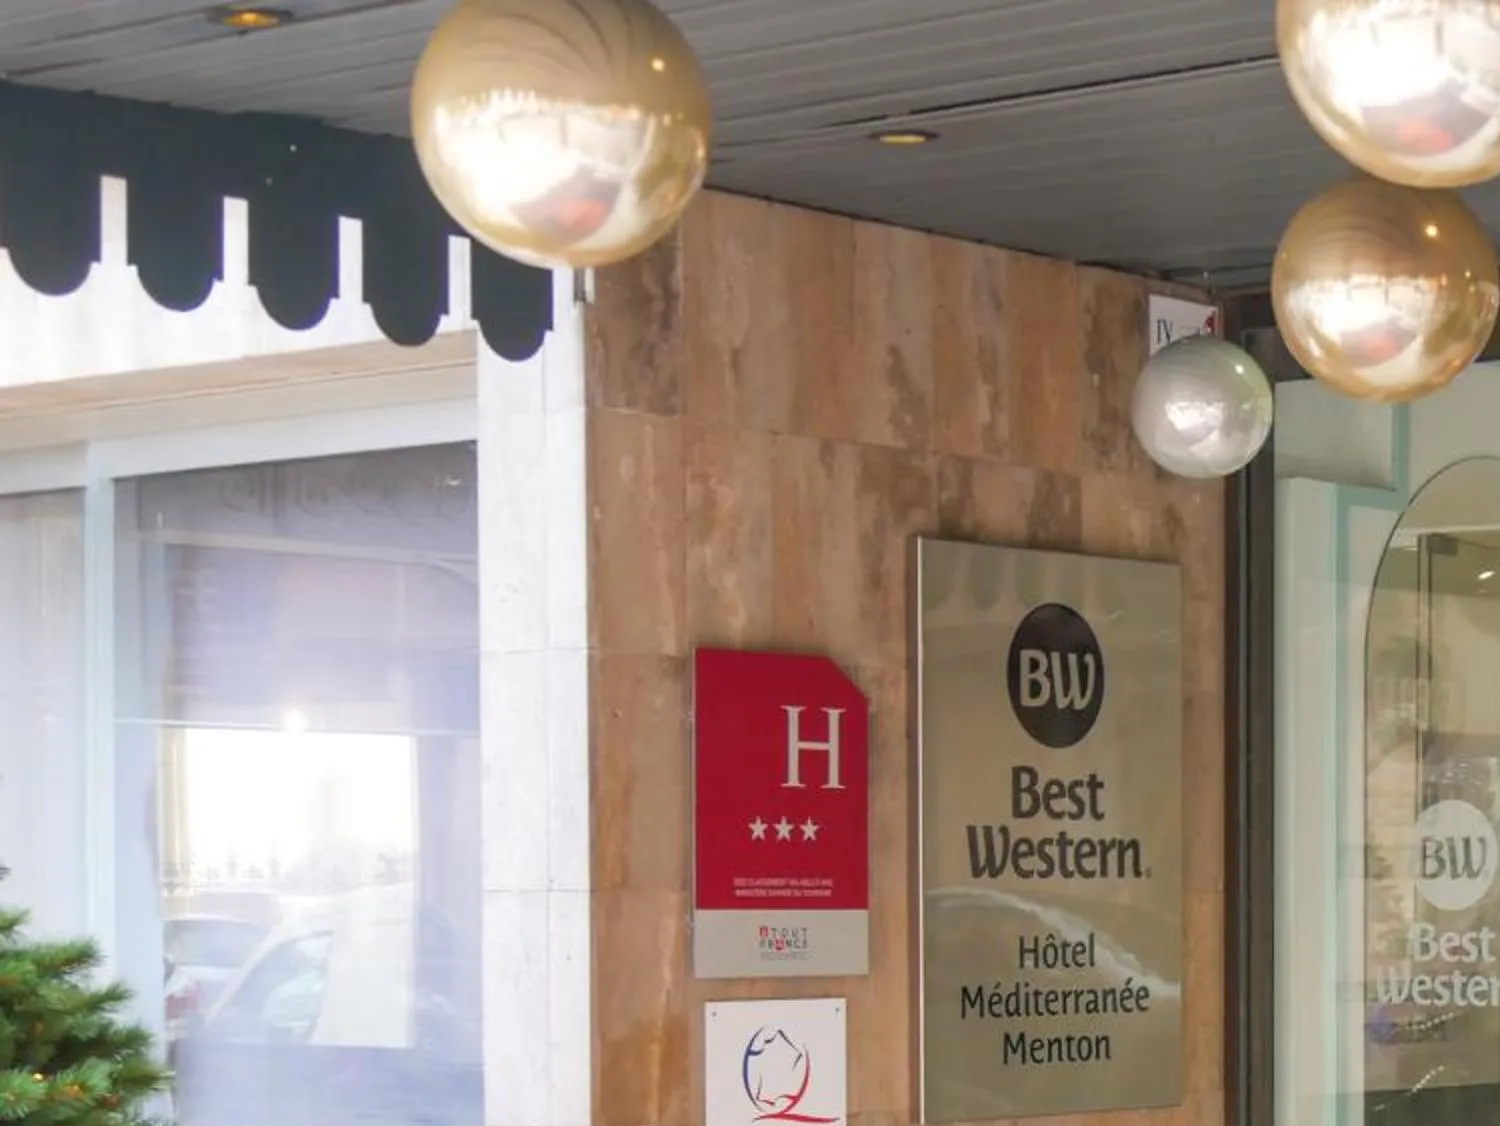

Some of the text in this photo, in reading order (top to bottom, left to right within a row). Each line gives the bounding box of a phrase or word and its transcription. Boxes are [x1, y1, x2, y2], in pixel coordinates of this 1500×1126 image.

[1019, 648, 1097, 710] BW
[780, 705, 848, 789] H
[1011, 765, 1106, 821] Best
[966, 824, 1145, 880] Western
[1420, 835, 1488, 880] BW
[1018, 932, 1096, 969] Hôtel
[1410, 921, 1497, 963] Best
[960, 976, 1150, 1020] Méditerranée
[1003, 1031, 1112, 1066] Menton
